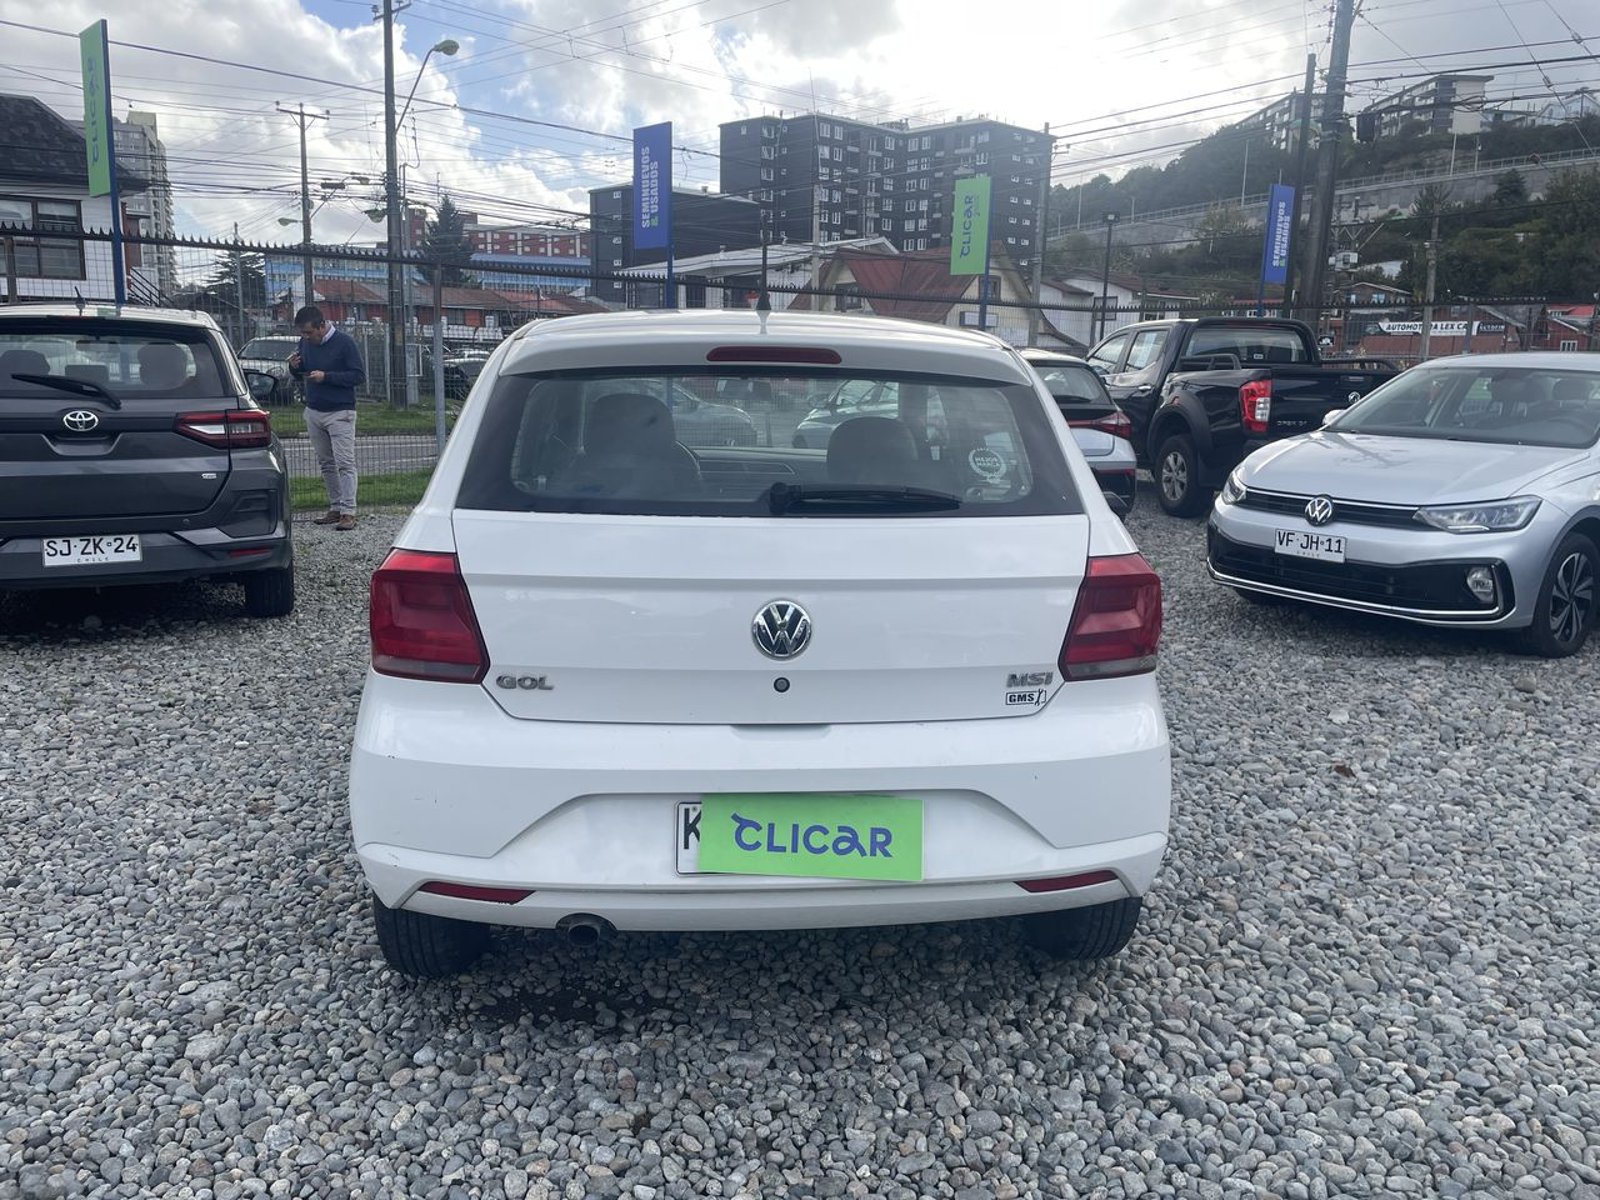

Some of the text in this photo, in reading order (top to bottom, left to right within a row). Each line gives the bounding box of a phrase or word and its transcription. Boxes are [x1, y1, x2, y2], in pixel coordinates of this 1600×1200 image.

[641, 146, 651, 229] SEMINUEVOS
[650, 161, 659, 213] USADOS
[496, 675, 554, 690] GOL
[1007, 672, 1054, 688] MSI
[1009, 693, 1035, 703] GMS
